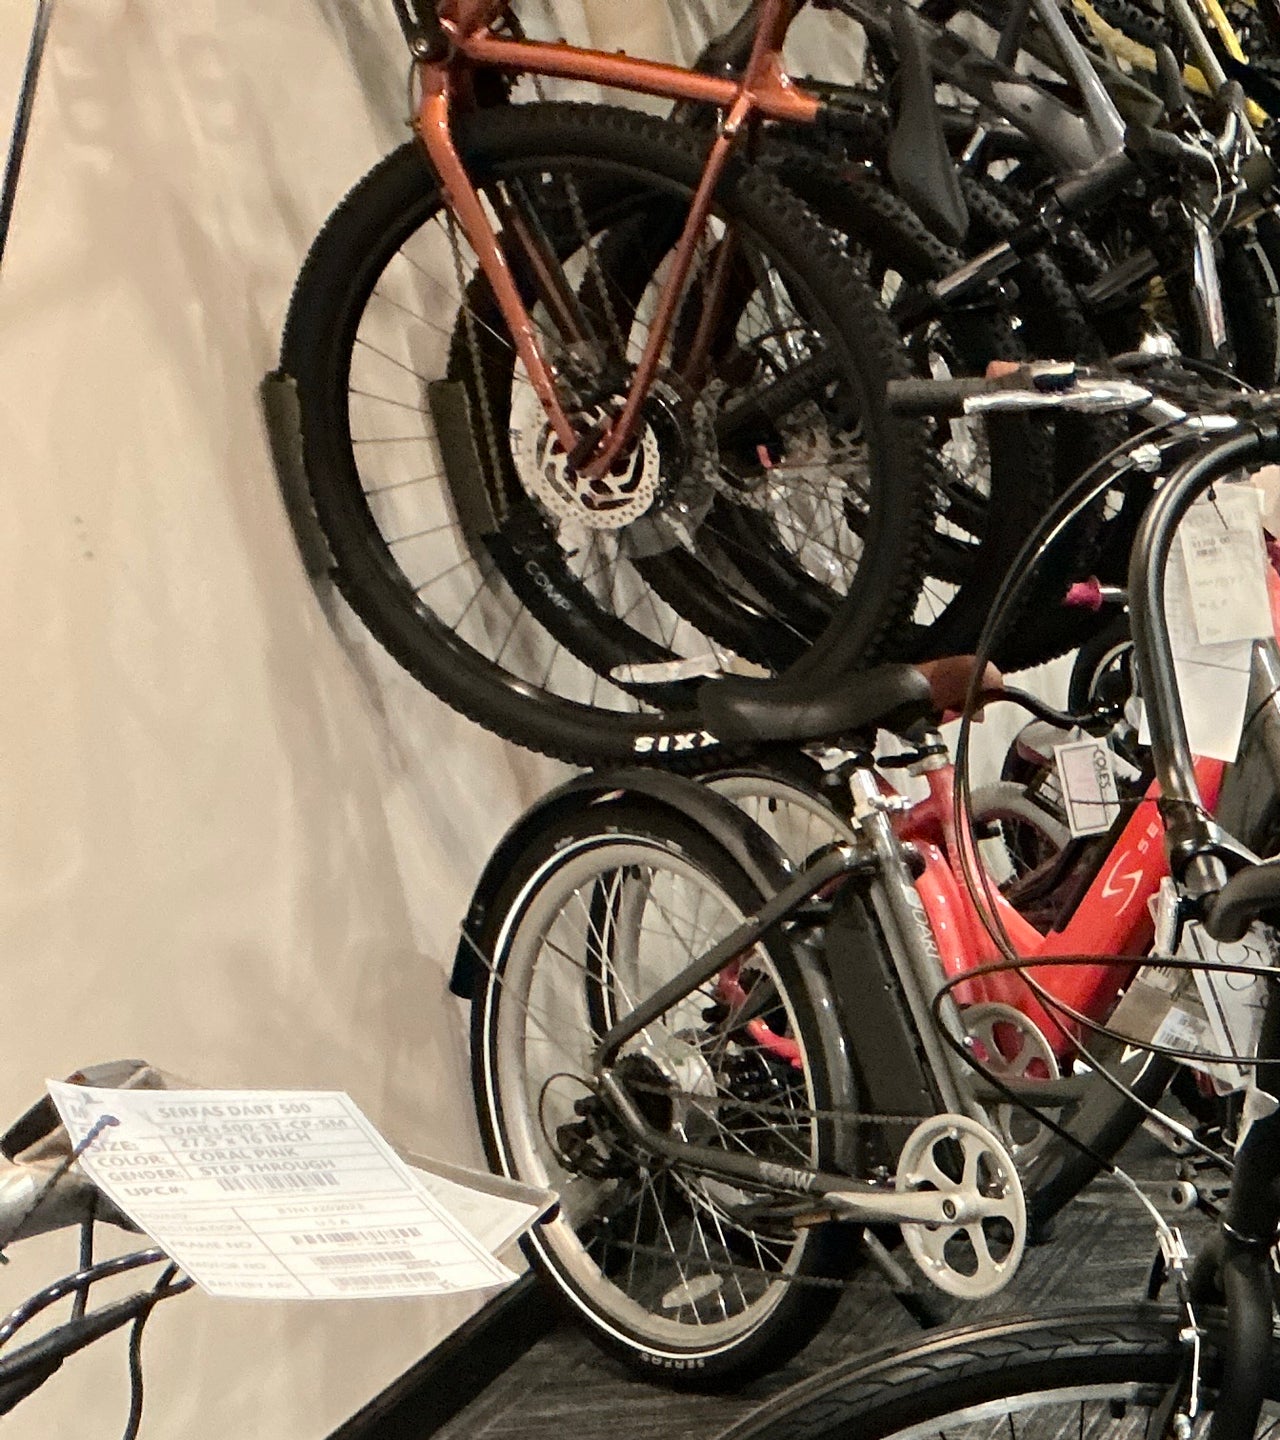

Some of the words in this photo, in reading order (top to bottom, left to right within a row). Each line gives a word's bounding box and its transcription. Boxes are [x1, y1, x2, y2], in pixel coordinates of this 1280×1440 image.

[158, 1106, 224, 1119] SERFAS
[228, 1105, 277, 1117] DART
[279, 1103, 312, 1115] 500
[265, 1131, 313, 1144] INCH
[189, 1149, 251, 1163] CORAL
[256, 1148, 300, 1159] PINK
[198, 1165, 241, 1177] STEP
[249, 1159, 337, 1173] THROUGH
